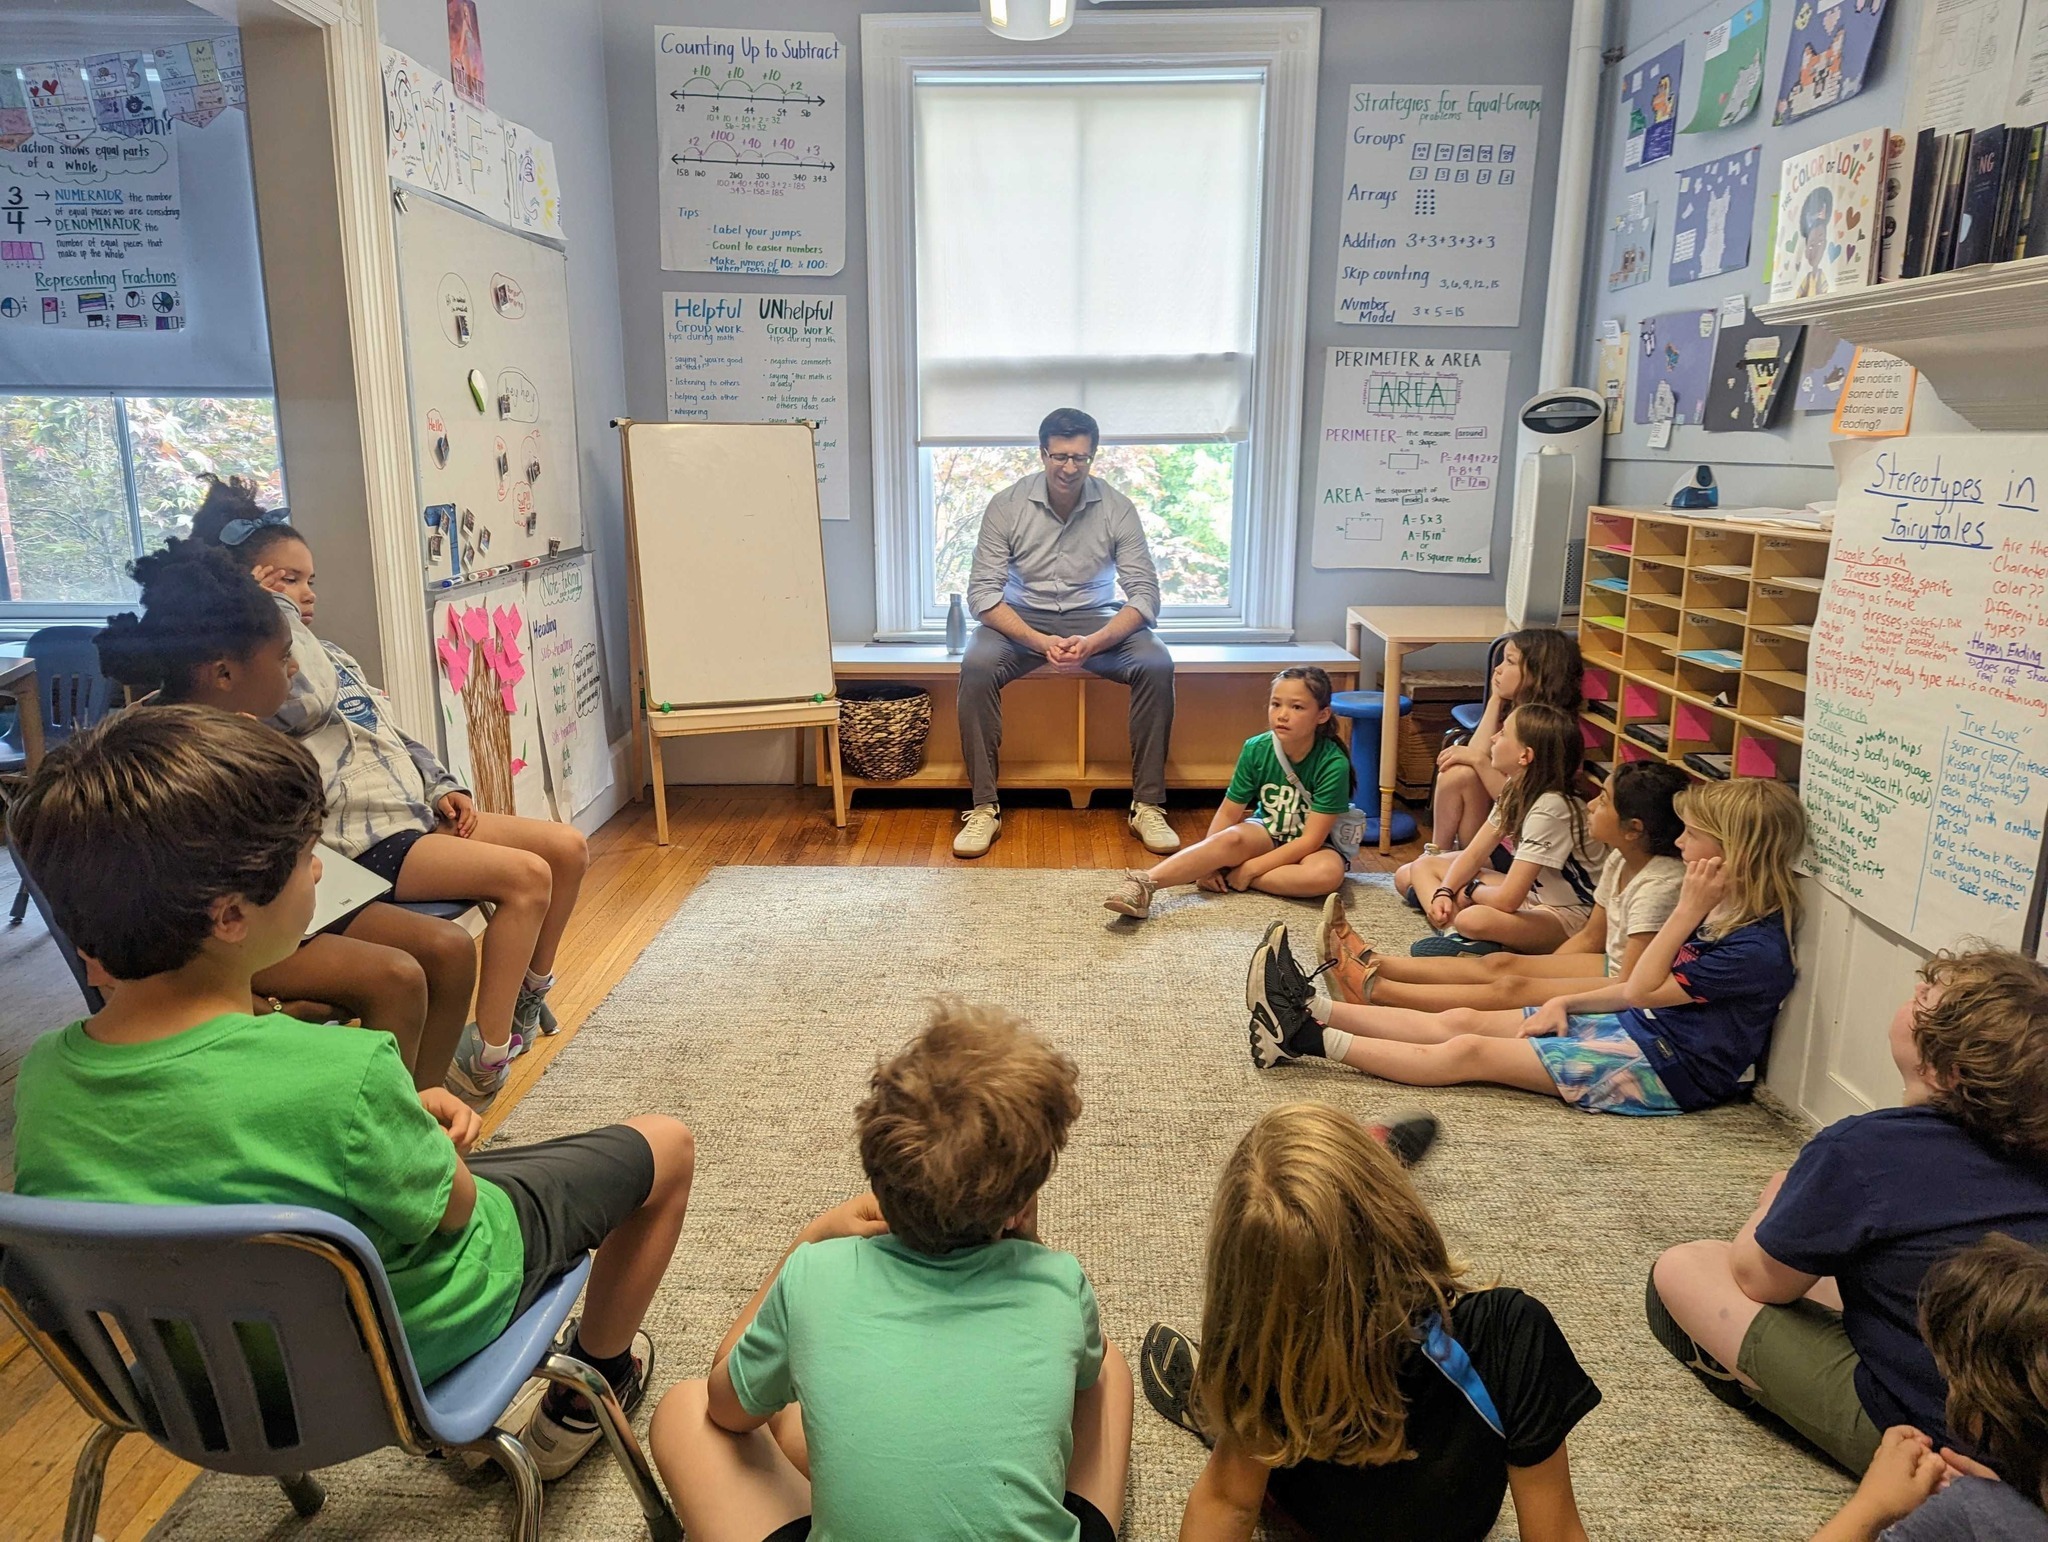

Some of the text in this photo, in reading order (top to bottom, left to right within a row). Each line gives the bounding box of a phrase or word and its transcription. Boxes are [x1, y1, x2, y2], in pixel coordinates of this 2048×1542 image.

[661, 33, 839, 64] Counting Up to Subtract
[692, 65, 711, 76] +10
[728, 67, 744, 78] +10
[763, 69, 781, 81] +10
[790, 82, 802, 90] +2
[676, 104, 685, 112] 24
[744, 107, 754, 115] 44
[1353, 90, 1461, 120] Strategies for
[1419, 111, 1463, 126] problems
[711, 130, 734, 142] +100
[1354, 126, 1406, 150] Groups
[60, 143, 149, 160] shows equal parts
[28, 156, 38, 168] of
[65, 160, 98, 172] whole
[1792, 151, 1866, 193] COLOR OF LOVE
[8, 186, 23, 205] 3
[55, 189, 123, 200] NUMERATOR
[129, 193, 143, 202] the
[1348, 184, 1398, 209] Arrays
[56, 208, 63, 216] of
[69, 207, 87, 218] equal
[7, 211, 25, 234] 4
[56, 219, 140, 231] DENOMINATOR
[713, 225, 801, 240] Label your jumps
[1342, 232, 1396, 248] Addition
[88, 239, 95, 247] of
[100, 239, 118, 250] equal
[123, 239, 143, 250] pieces
[712, 241, 740, 250] Count
[745, 242, 753, 250] to
[786, 244, 823, 254] numbers
[105, 250, 124, 258] whole
[710, 257, 778, 270] Make jumps of
[746, 266, 779, 274] possible
[35, 268, 176, 292] Representing Fractions
[1342, 264, 1430, 288] Skip counting
[675, 298, 742, 324] Helpful
[1341, 297, 1389, 311] Number
[759, 298, 833, 326] UNhelpful
[1359, 310, 1395, 323] Model
[676, 320, 741, 337] Group work
[767, 324, 834, 337] Group work
[669, 333, 682, 342] tips
[687, 333, 713, 345] during
[769, 336, 784, 344] tips
[787, 335, 811, 348] during
[675, 356, 743, 367] saying good
[770, 358, 798, 368] negative
[1335, 350, 1481, 368] PERIMETER & AREA
[676, 378, 705, 391] listening
[769, 373, 788, 382] saying
[1867, 374, 1892, 383] notice
[1894, 373, 1901, 382] in
[675, 392, 697, 405] helping
[701, 392, 717, 400] each
[781, 395, 808, 406] listening
[1379, 381, 1445, 407] AREA
[1848, 389, 1899, 398] some of the
[675, 409, 708, 420] whispering
[1843, 404, 1875, 413] stories
[428, 417, 442, 431] Hello
[1839, 420, 1881, 431] reading?
[1418, 439, 1438, 448] shape
[1871, 452, 2035, 515] Stereotypes in
[1891, 503, 1985, 550] Fairytales
[2002, 537, 2023, 553] Are
[1427, 553, 1453, 564] square
[1884, 590, 1915, 611] female
[1863, 607, 1901, 629] dresses
[1985, 598, 2032, 624] Different
[533, 614, 557, 640] Heading
[1984, 621, 2026, 638] types?
[1971, 632, 2041, 663] Happy Ending
[1894, 661, 1942, 689] body type
[1976, 660, 2020, 675] does not
[2002, 676, 2017, 688] life
[553, 683, 566, 697] Note
[1901, 736, 1922, 757] hips
[1864, 745, 1932, 784] body language
[1967, 791, 1995, 808] other
[1940, 800, 2041, 840] mostly another
[1933, 832, 1956, 852] Male
[1930, 864, 1946, 879] Love
[1947, 855, 2026, 896] showing affection
